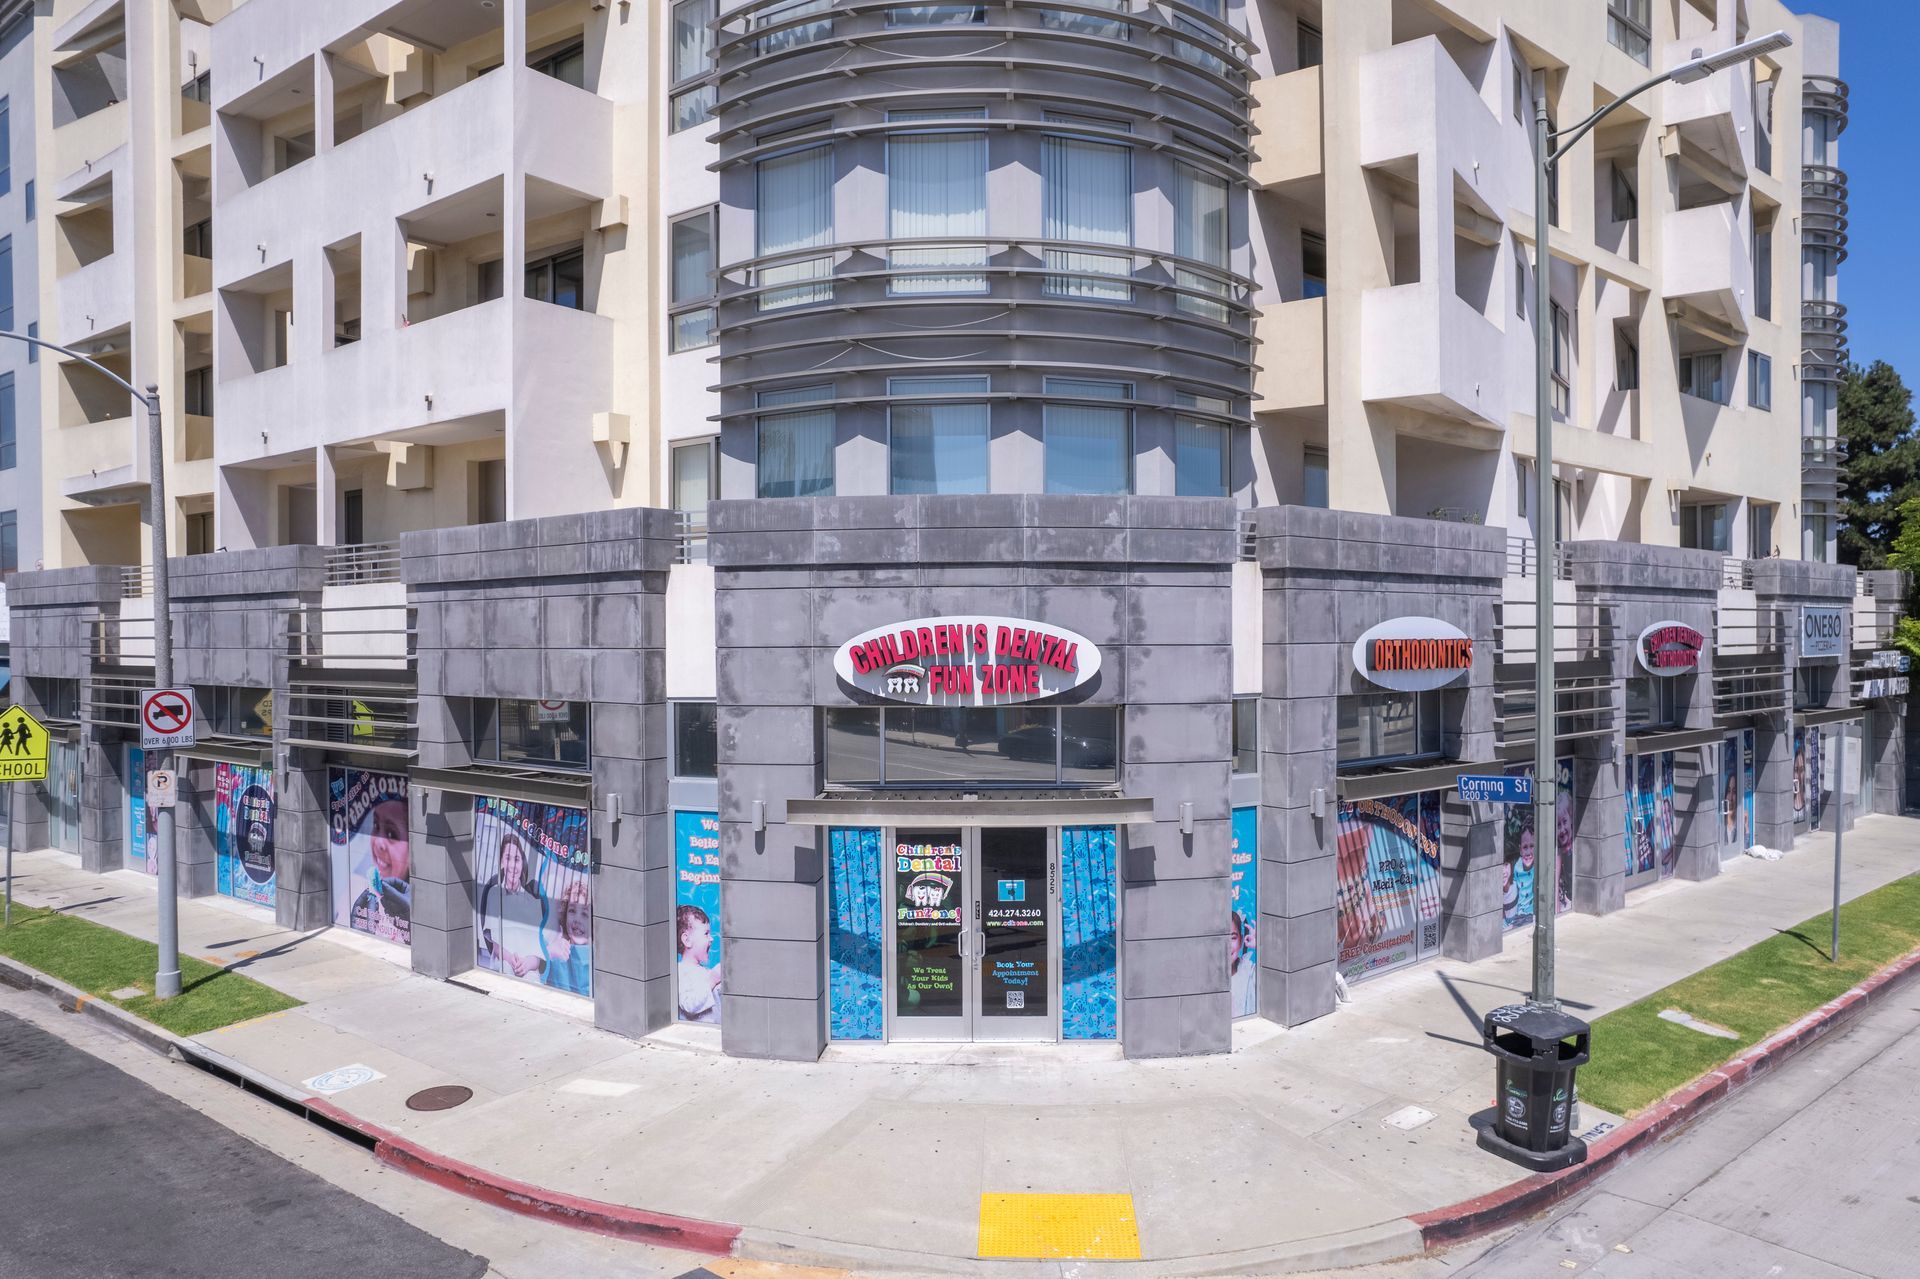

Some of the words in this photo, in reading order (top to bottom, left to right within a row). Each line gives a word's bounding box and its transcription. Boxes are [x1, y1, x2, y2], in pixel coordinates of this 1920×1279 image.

[849, 623, 988, 675] CHILDREN'S
[995, 625, 1079, 674] DENTAL
[1375, 638, 1473, 672] ORTHODONTICS
[930, 664, 974, 695] FUN
[981, 663, 1041, 695] ZONE
[143, 736, 160, 746] OVER
[181, 735, 193, 744] LBS
[0, 762, 42, 776] HOOL
[1461, 777, 1504, 796] Corning
[1514, 779, 1528, 793] St
[1462, 791, 1480, 800] 1200
[1484, 792, 1489, 800] S
[487, 796, 589, 866] www.cdfzone.co
[701, 818, 719, 831] We
[1358, 798, 1438, 859] ORTHODONICS
[689, 836, 719, 849] Belie
[897, 843, 962, 856] Children's
[689, 853, 702, 865] In
[705, 854, 719, 866] Ea
[897, 856, 962, 872] Dental
[1379, 859, 1397, 872] PPO
[680, 870, 720, 885] Beginn
[897, 907, 962, 922] FunZone!
[988, 909, 1042, 918] 424.274.3260
[1340, 947, 1361, 961] FREE
[1362, 929, 1415, 954] Consultation!
[931, 974, 949, 982] Kids
[992, 970, 1039, 978] Appointment
[934, 982, 954, 991] Own!
[1003, 977, 1029, 986] Today!
